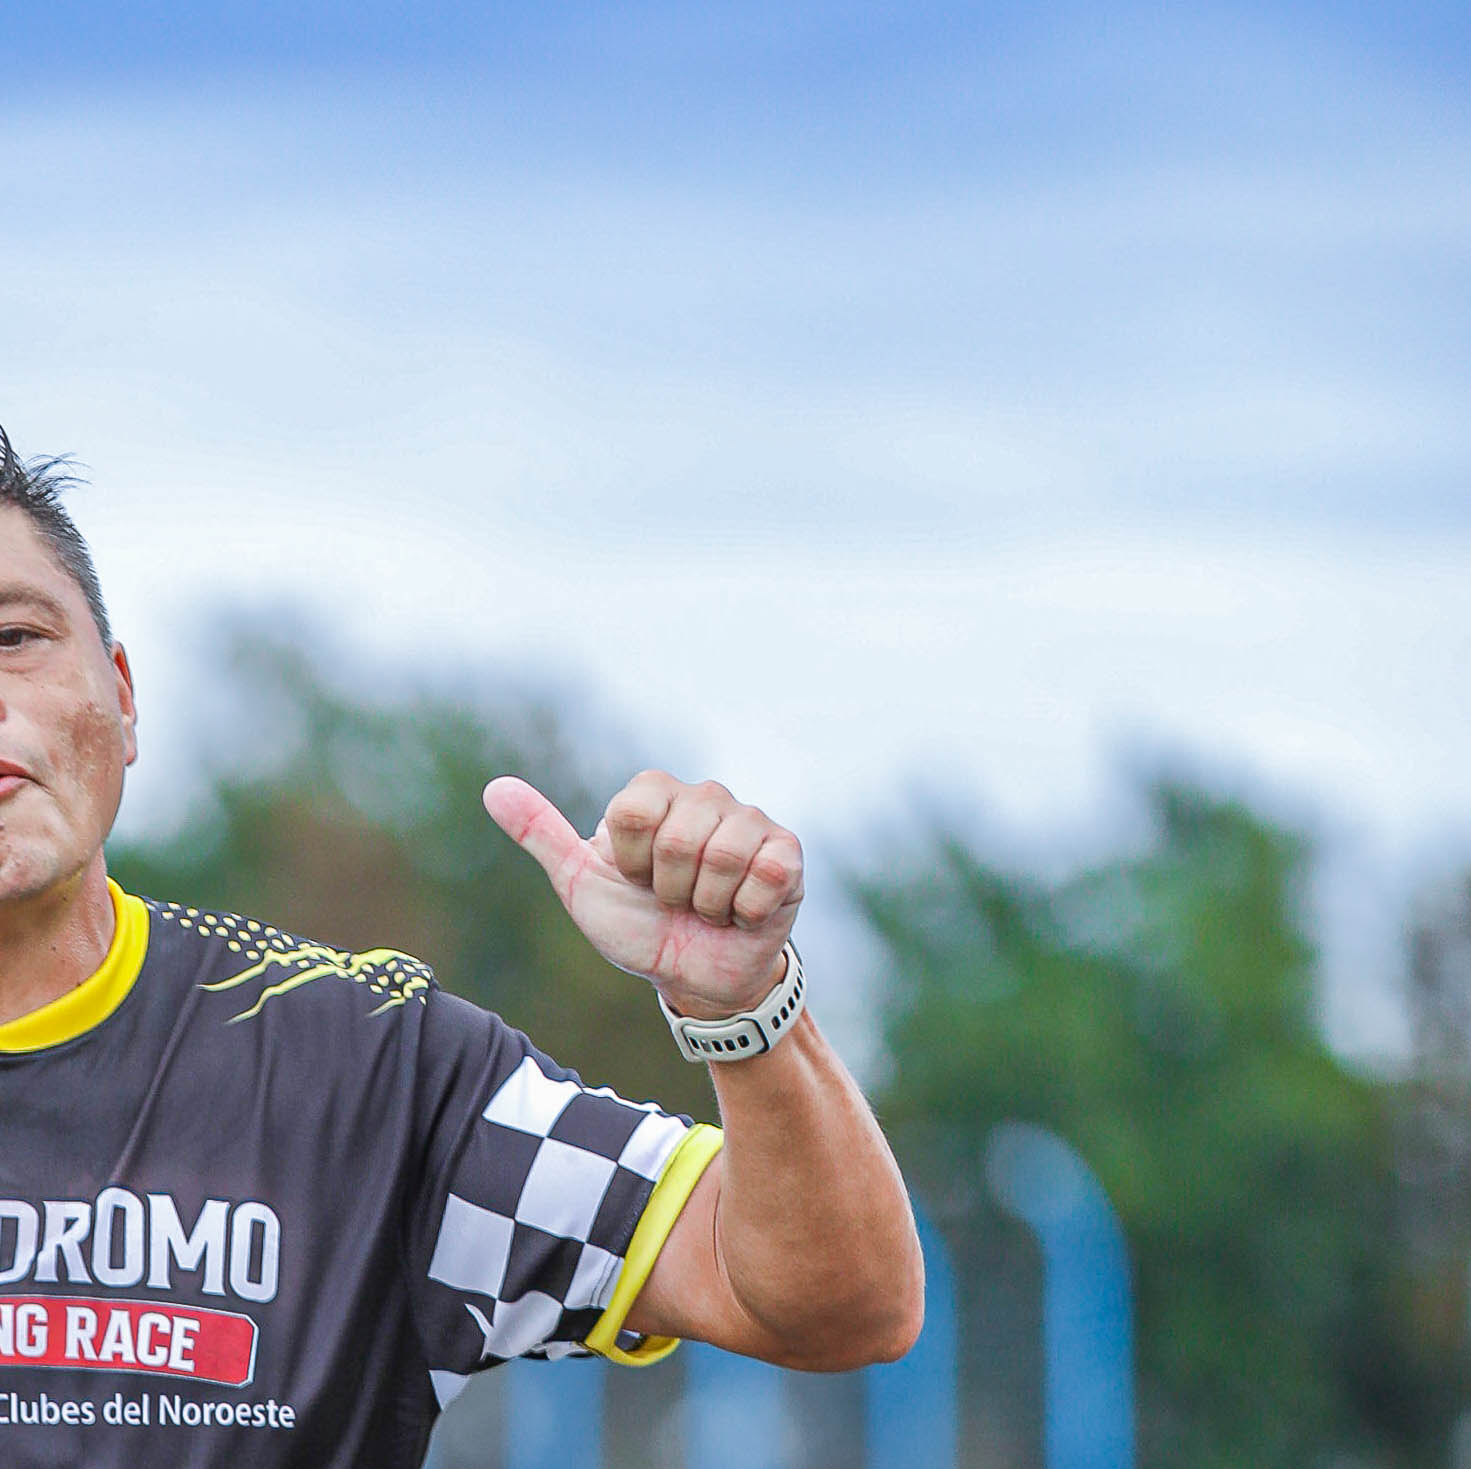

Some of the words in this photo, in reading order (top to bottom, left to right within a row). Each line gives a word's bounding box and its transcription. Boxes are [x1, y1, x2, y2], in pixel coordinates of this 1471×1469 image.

[64, 1305, 202, 1373] RACE
[102, 1392, 150, 1427] del
[158, 1394, 297, 1430] Noroeste
